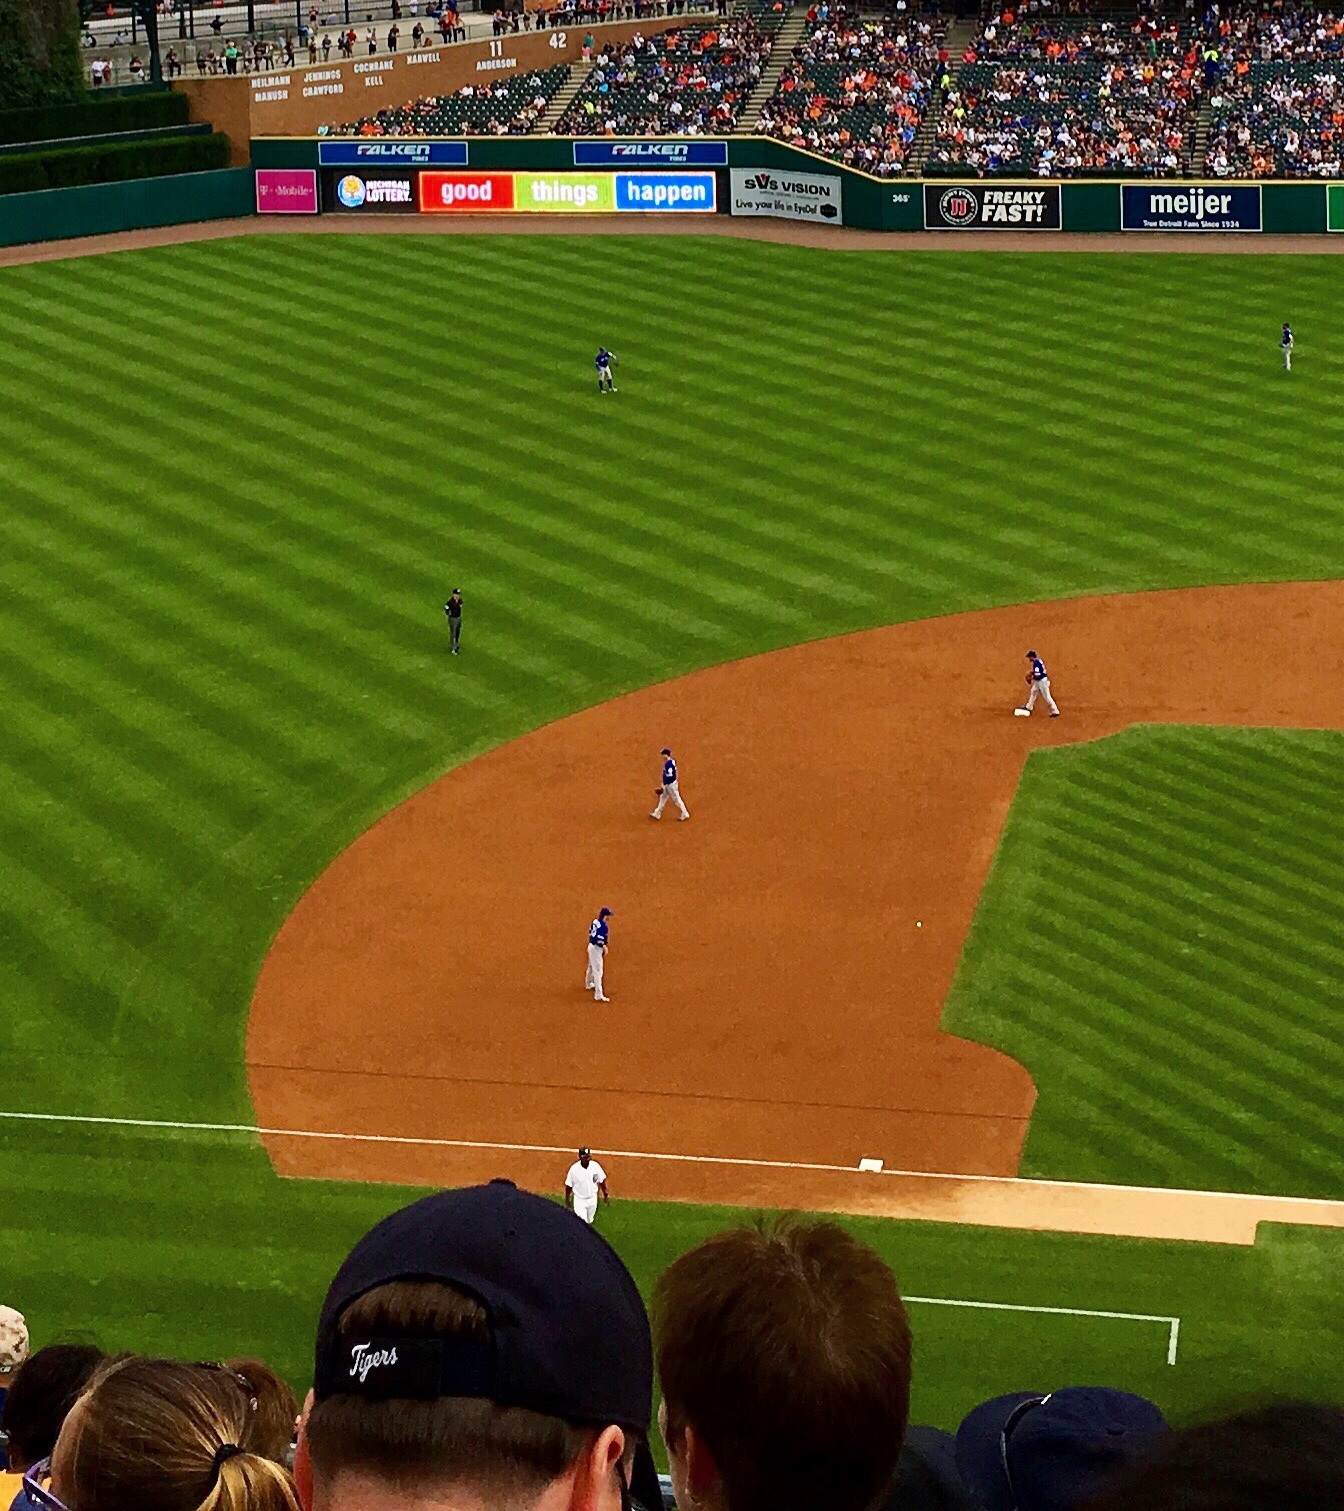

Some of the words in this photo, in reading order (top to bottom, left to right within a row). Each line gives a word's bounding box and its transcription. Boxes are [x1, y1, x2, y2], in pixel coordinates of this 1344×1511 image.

[548, 32, 567, 49] 42
[488, 40, 503, 57] 11
[353, 59, 395, 73] COCHRANE
[476, 57, 517, 71] ANDERSON
[251, 75, 292, 89] HEILMANN
[303, 69, 342, 83] JENNINGS
[364, 75, 384, 87] KELL
[302, 83, 344, 98] CRAWFORD
[357, 144, 430, 155] FALKEN
[611, 144, 689, 156] FALKEN
[365, 180, 410, 190] MICHIGAN
[782, 181, 831, 197] VISION
[441, 180, 492, 205] good
[531, 180, 599, 206] things
[627, 180, 706, 206] happen
[983, 191, 1046, 204] FREAKY
[735, 199, 753, 209] Live
[755, 201, 773, 211] your
[1150, 188, 1232, 220] meijer
[981, 204, 1044, 222] FAST!
[349, 1341, 399, 1383] Tigers
